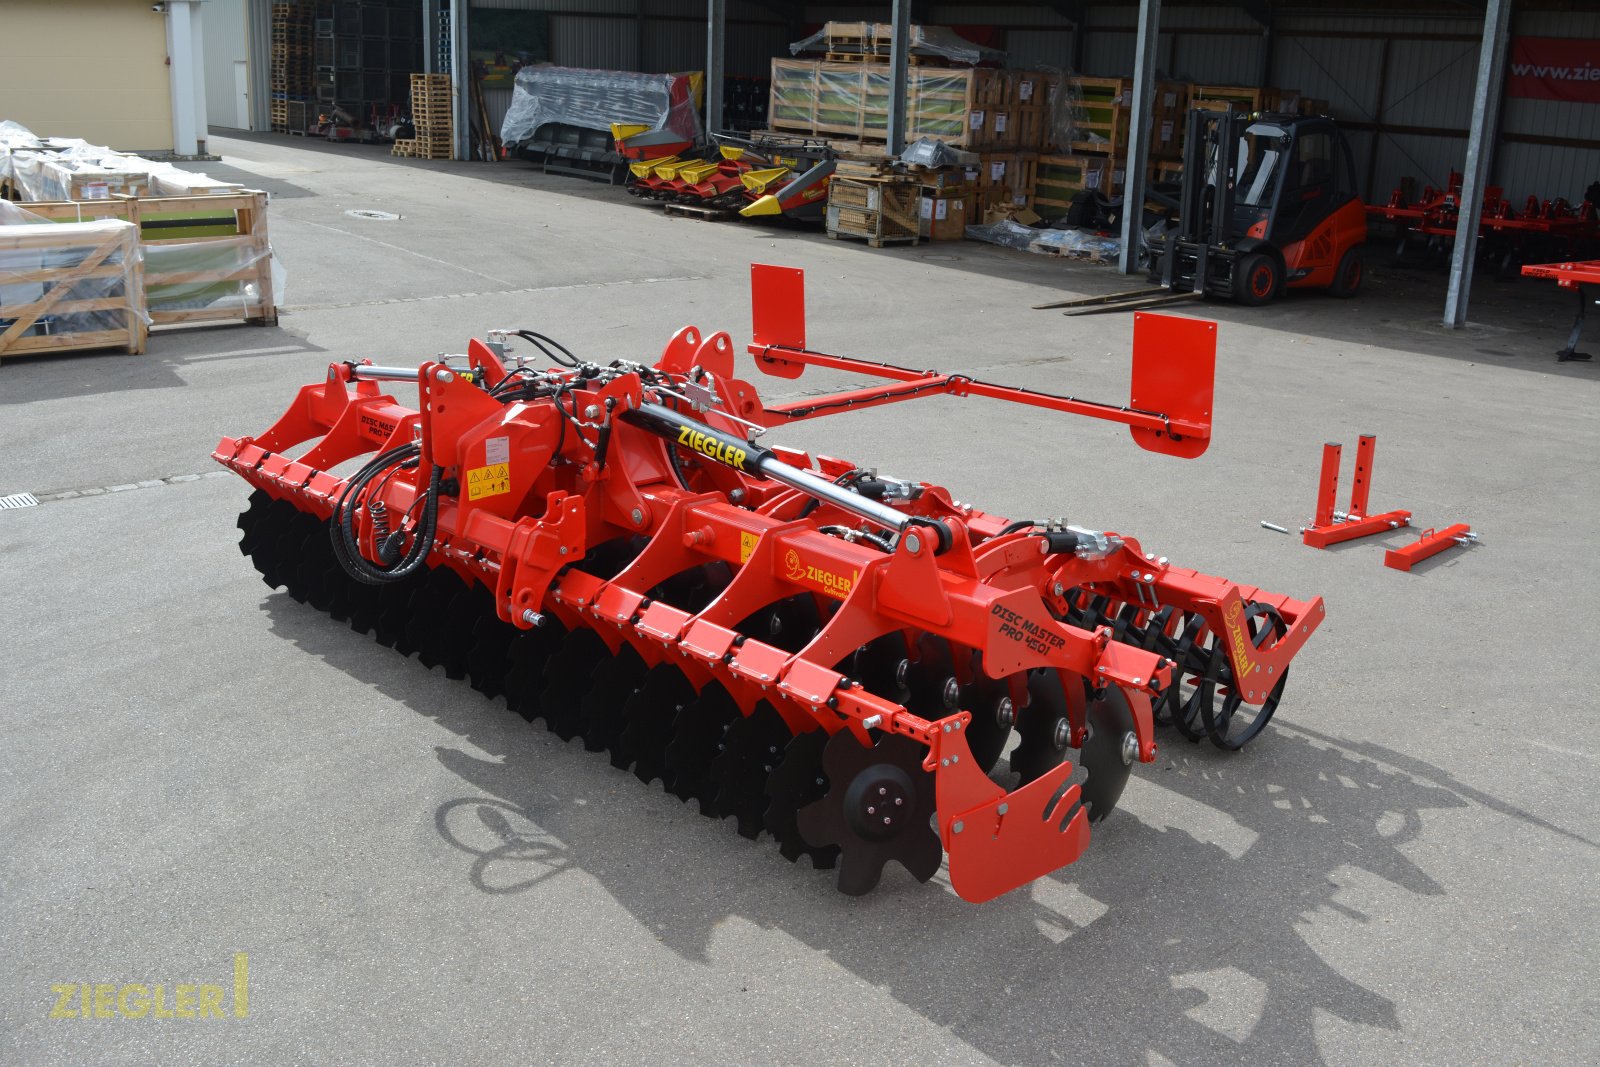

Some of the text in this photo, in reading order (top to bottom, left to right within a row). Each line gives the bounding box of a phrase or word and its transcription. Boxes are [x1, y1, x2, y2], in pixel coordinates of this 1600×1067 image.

[362, 416, 378, 427] DISC
[369, 426, 383, 437] PRO
[677, 425, 747, 471] ZIEGLER
[991, 604, 1066, 650] DISC MASTER
[998, 622, 1051, 656] PRO 4501
